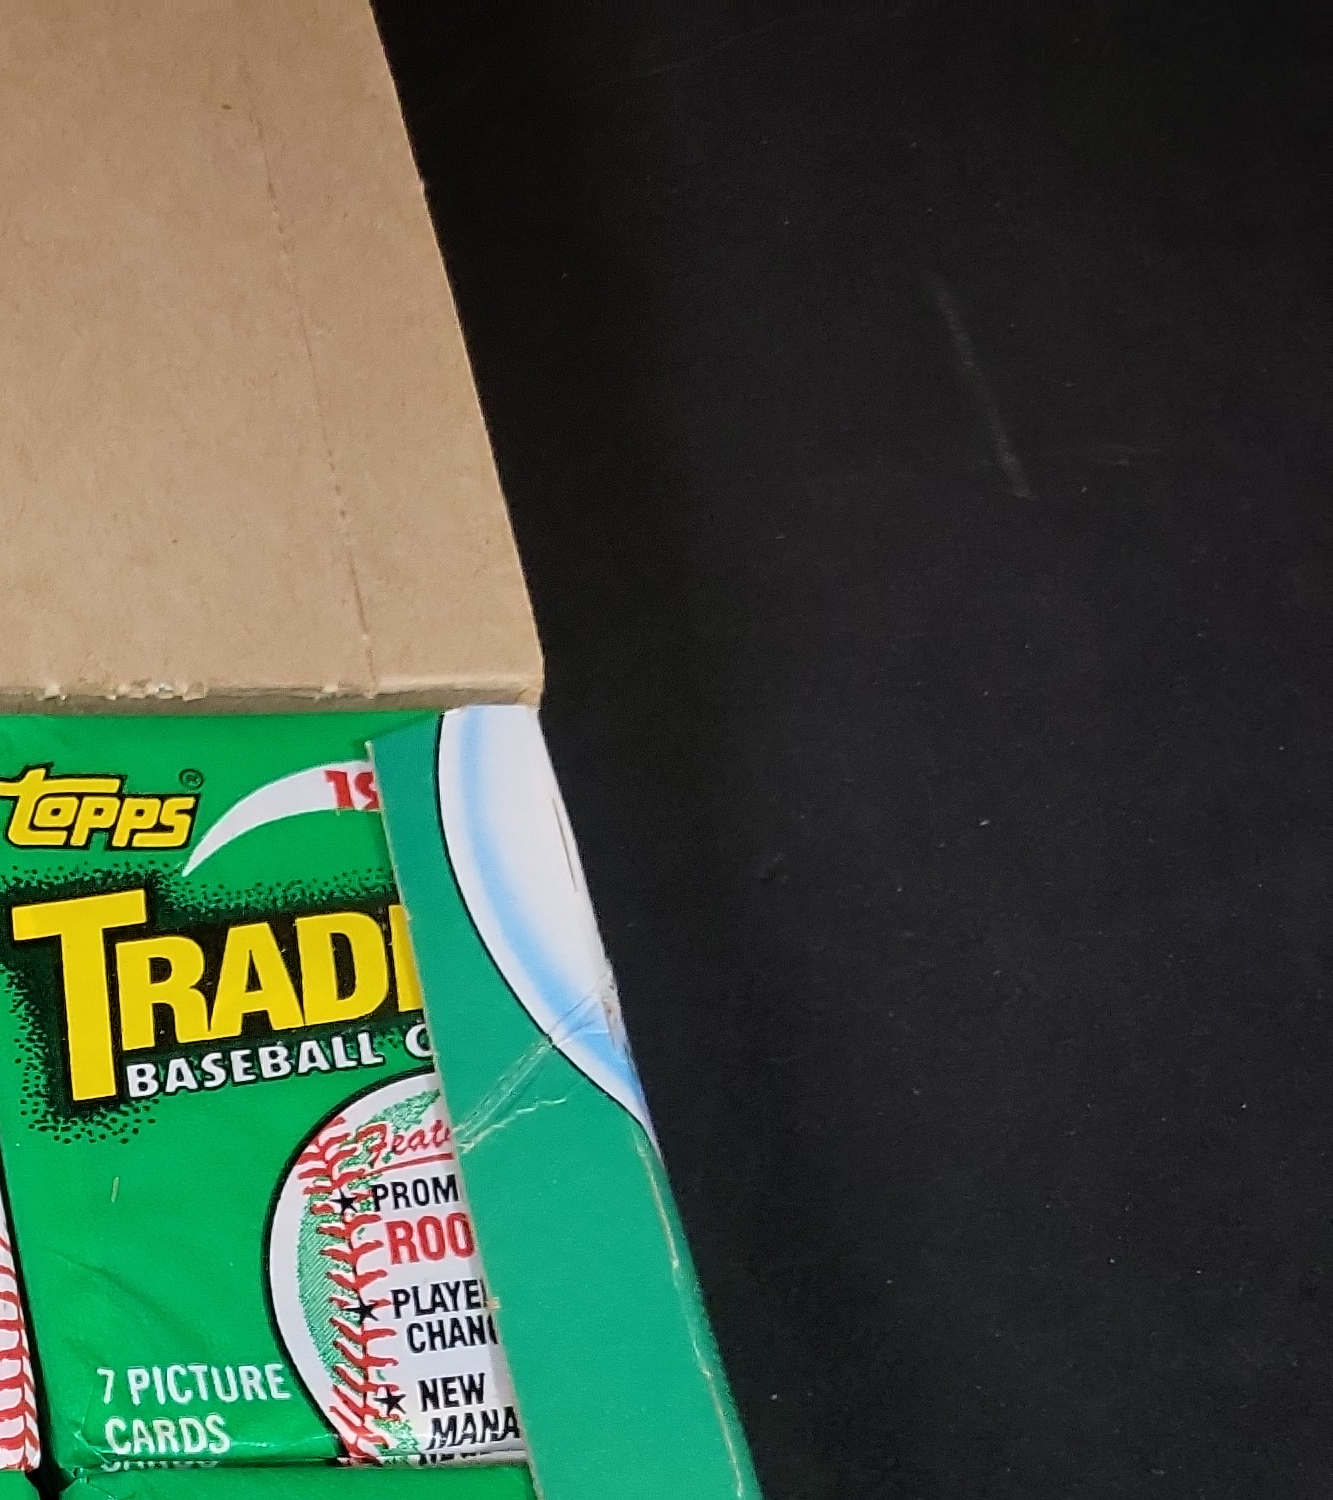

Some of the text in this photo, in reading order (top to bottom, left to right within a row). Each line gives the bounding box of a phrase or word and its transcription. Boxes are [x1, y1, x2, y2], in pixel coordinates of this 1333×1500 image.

[127, 1031, 383, 1099] BASEBALL
[356, 1119, 450, 1167] Feat
[97, 1363, 291, 1405] 7 PICTURE
[417, 1372, 485, 1412] NEW
[104, 1414, 231, 1454] CARDS
